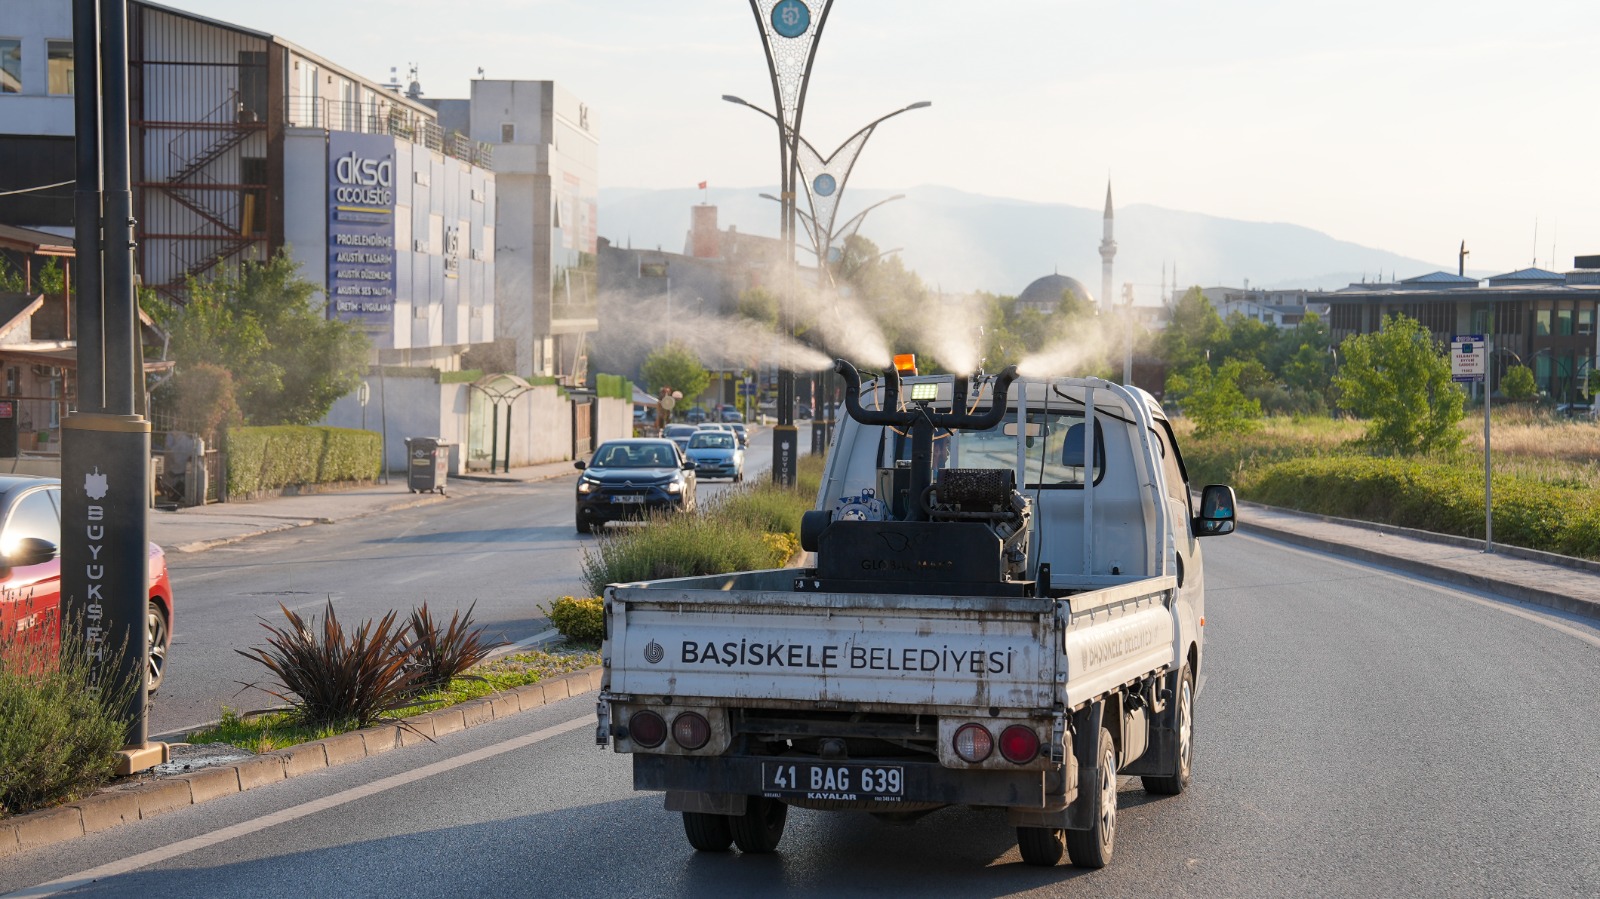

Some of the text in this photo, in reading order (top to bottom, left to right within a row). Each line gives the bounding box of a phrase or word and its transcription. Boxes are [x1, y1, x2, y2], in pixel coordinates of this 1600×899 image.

[337, 151, 391, 187] aksa
[337, 187, 391, 205] acoustic
[337, 233, 392, 247] PROJELENDİRME
[337, 250, 392, 264] AKUSTİK TASARIM
[337, 268, 360, 279] AKUSTİK
[337, 284, 360, 295] AKUSTİK
[361, 287, 371, 296] SES
[337, 300, 358, 311] ÜRETİM
[682, 638, 1011, 673] BAŞİSKELE BELEDİYESİ
[774, 765, 900, 793] 41 BAG 639
[807, 792, 857, 801] KAYALAR
